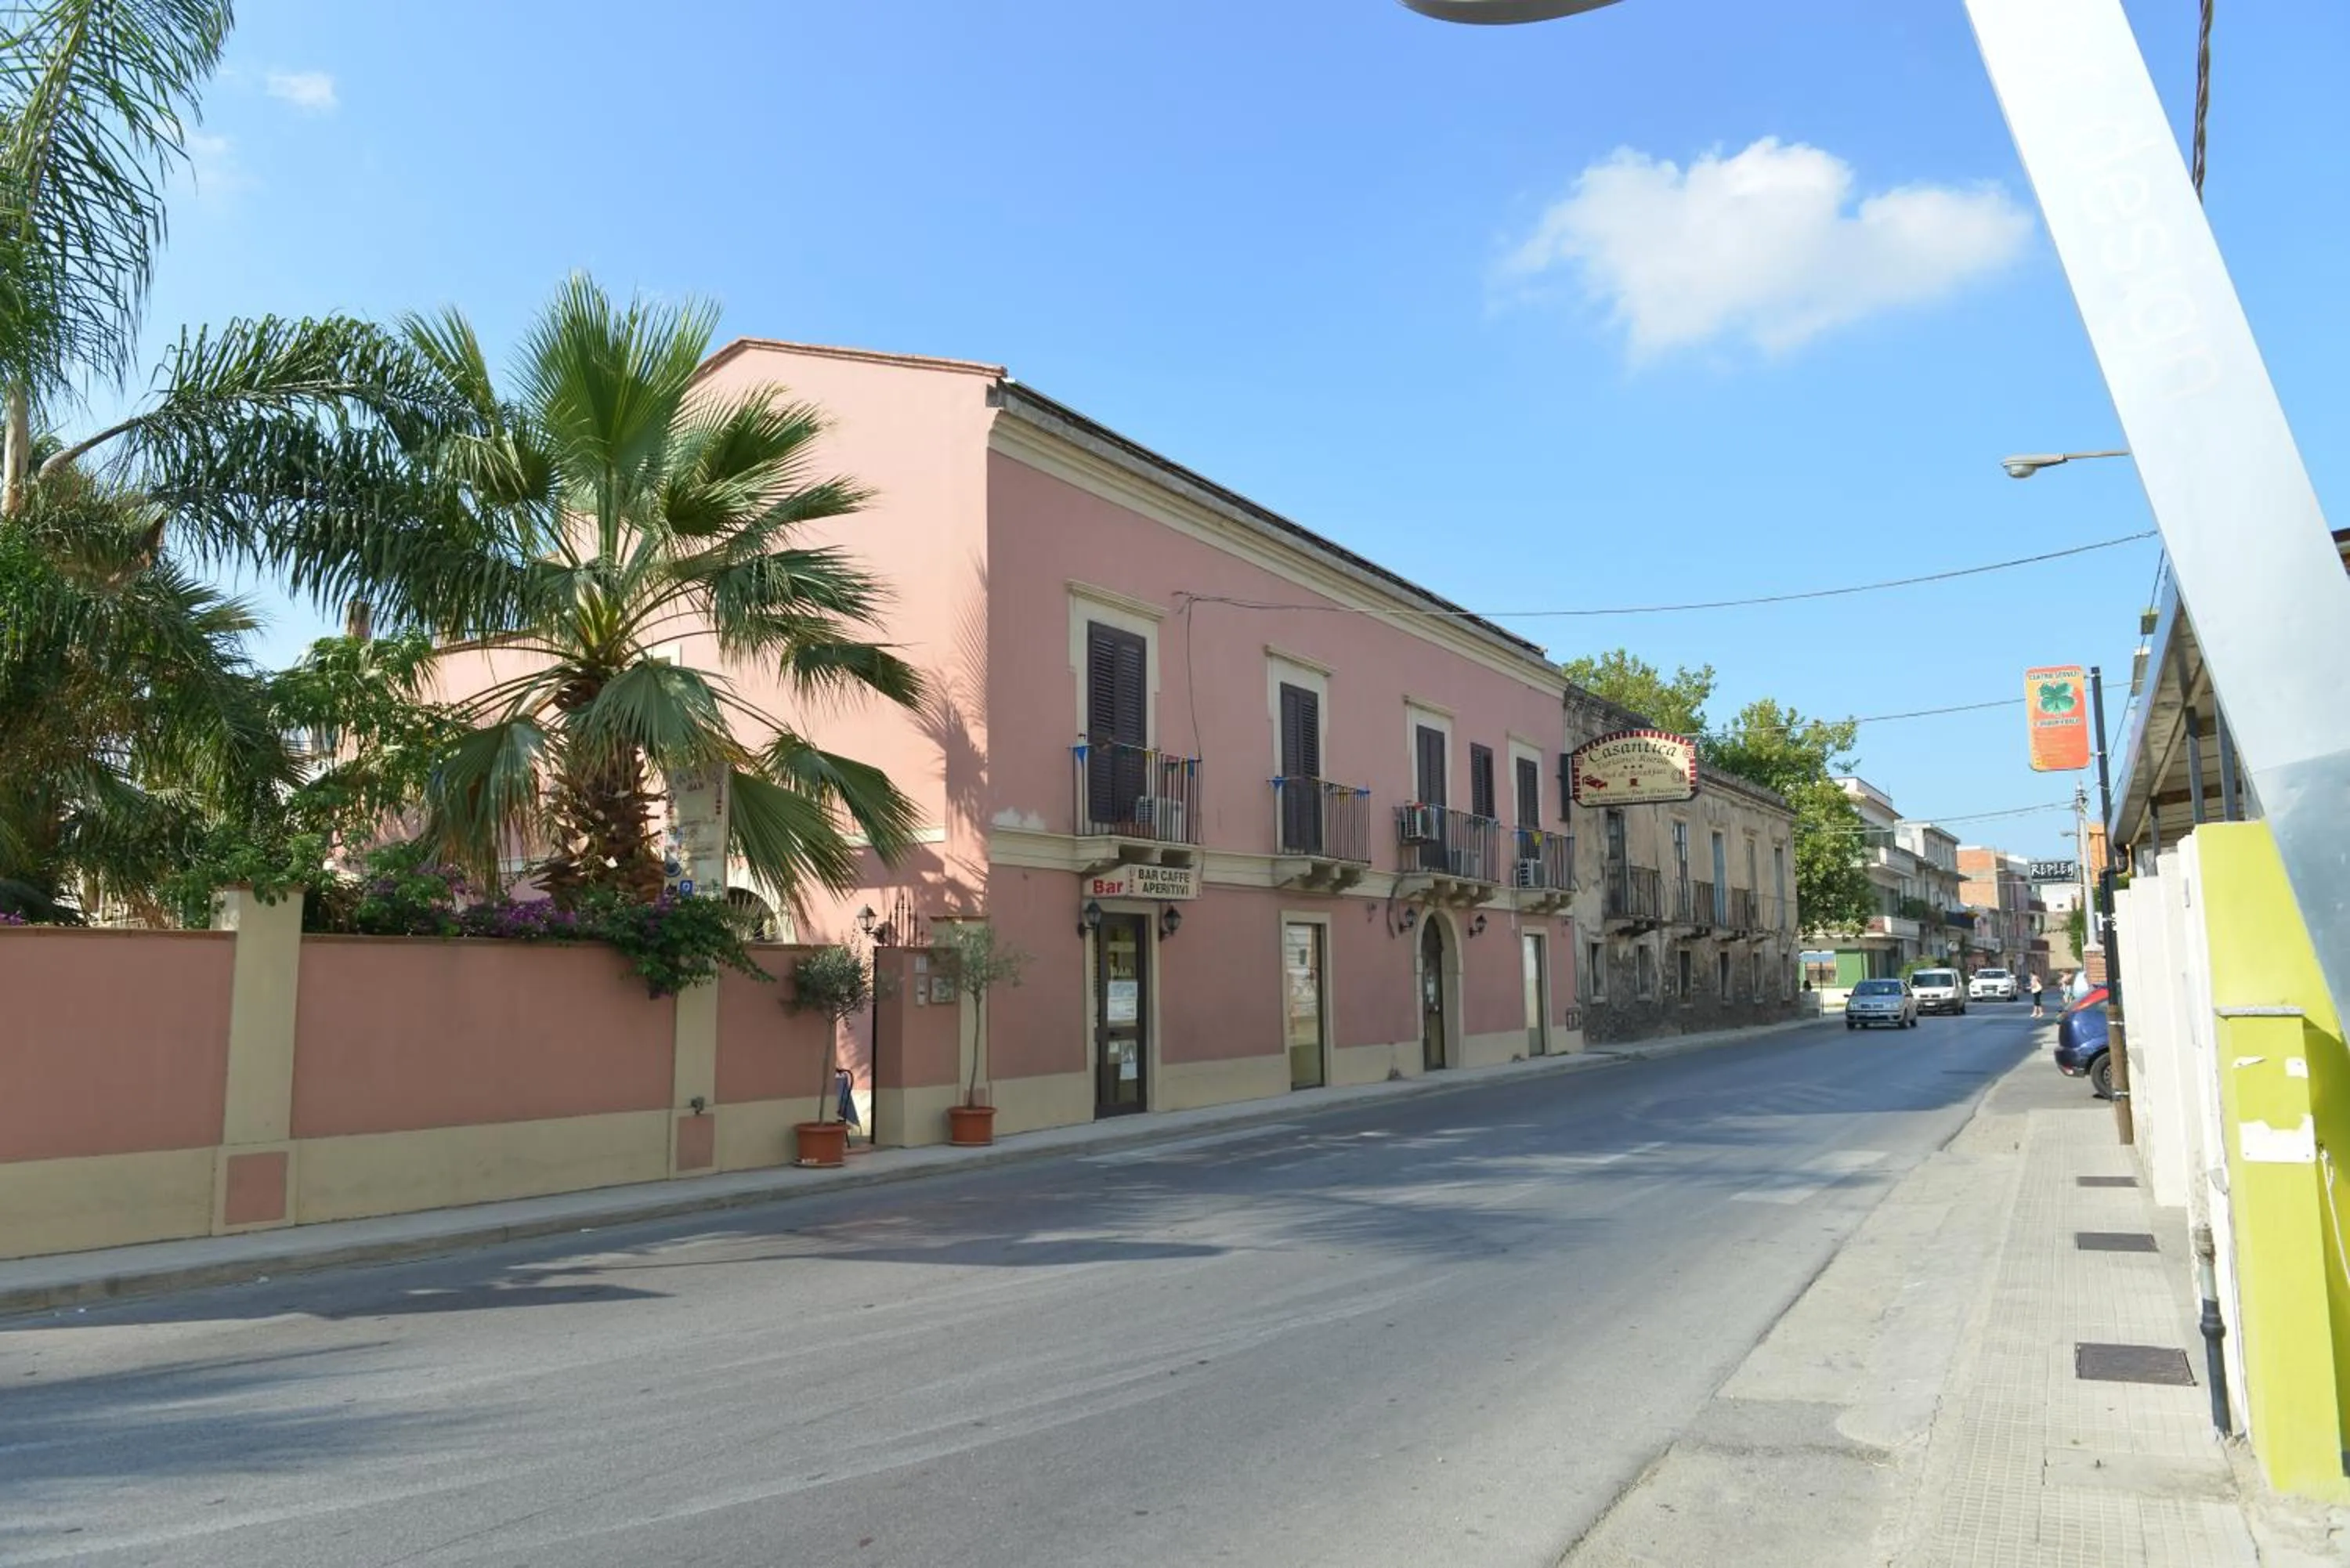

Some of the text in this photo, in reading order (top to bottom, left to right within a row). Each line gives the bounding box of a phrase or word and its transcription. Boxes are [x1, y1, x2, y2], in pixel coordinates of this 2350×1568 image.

[1589, 741, 1677, 762] Casantica
[1138, 869, 1158, 881] BAR
[1093, 879, 1123, 894] Bar
[1142, 882, 1189, 896] APERITIVI
